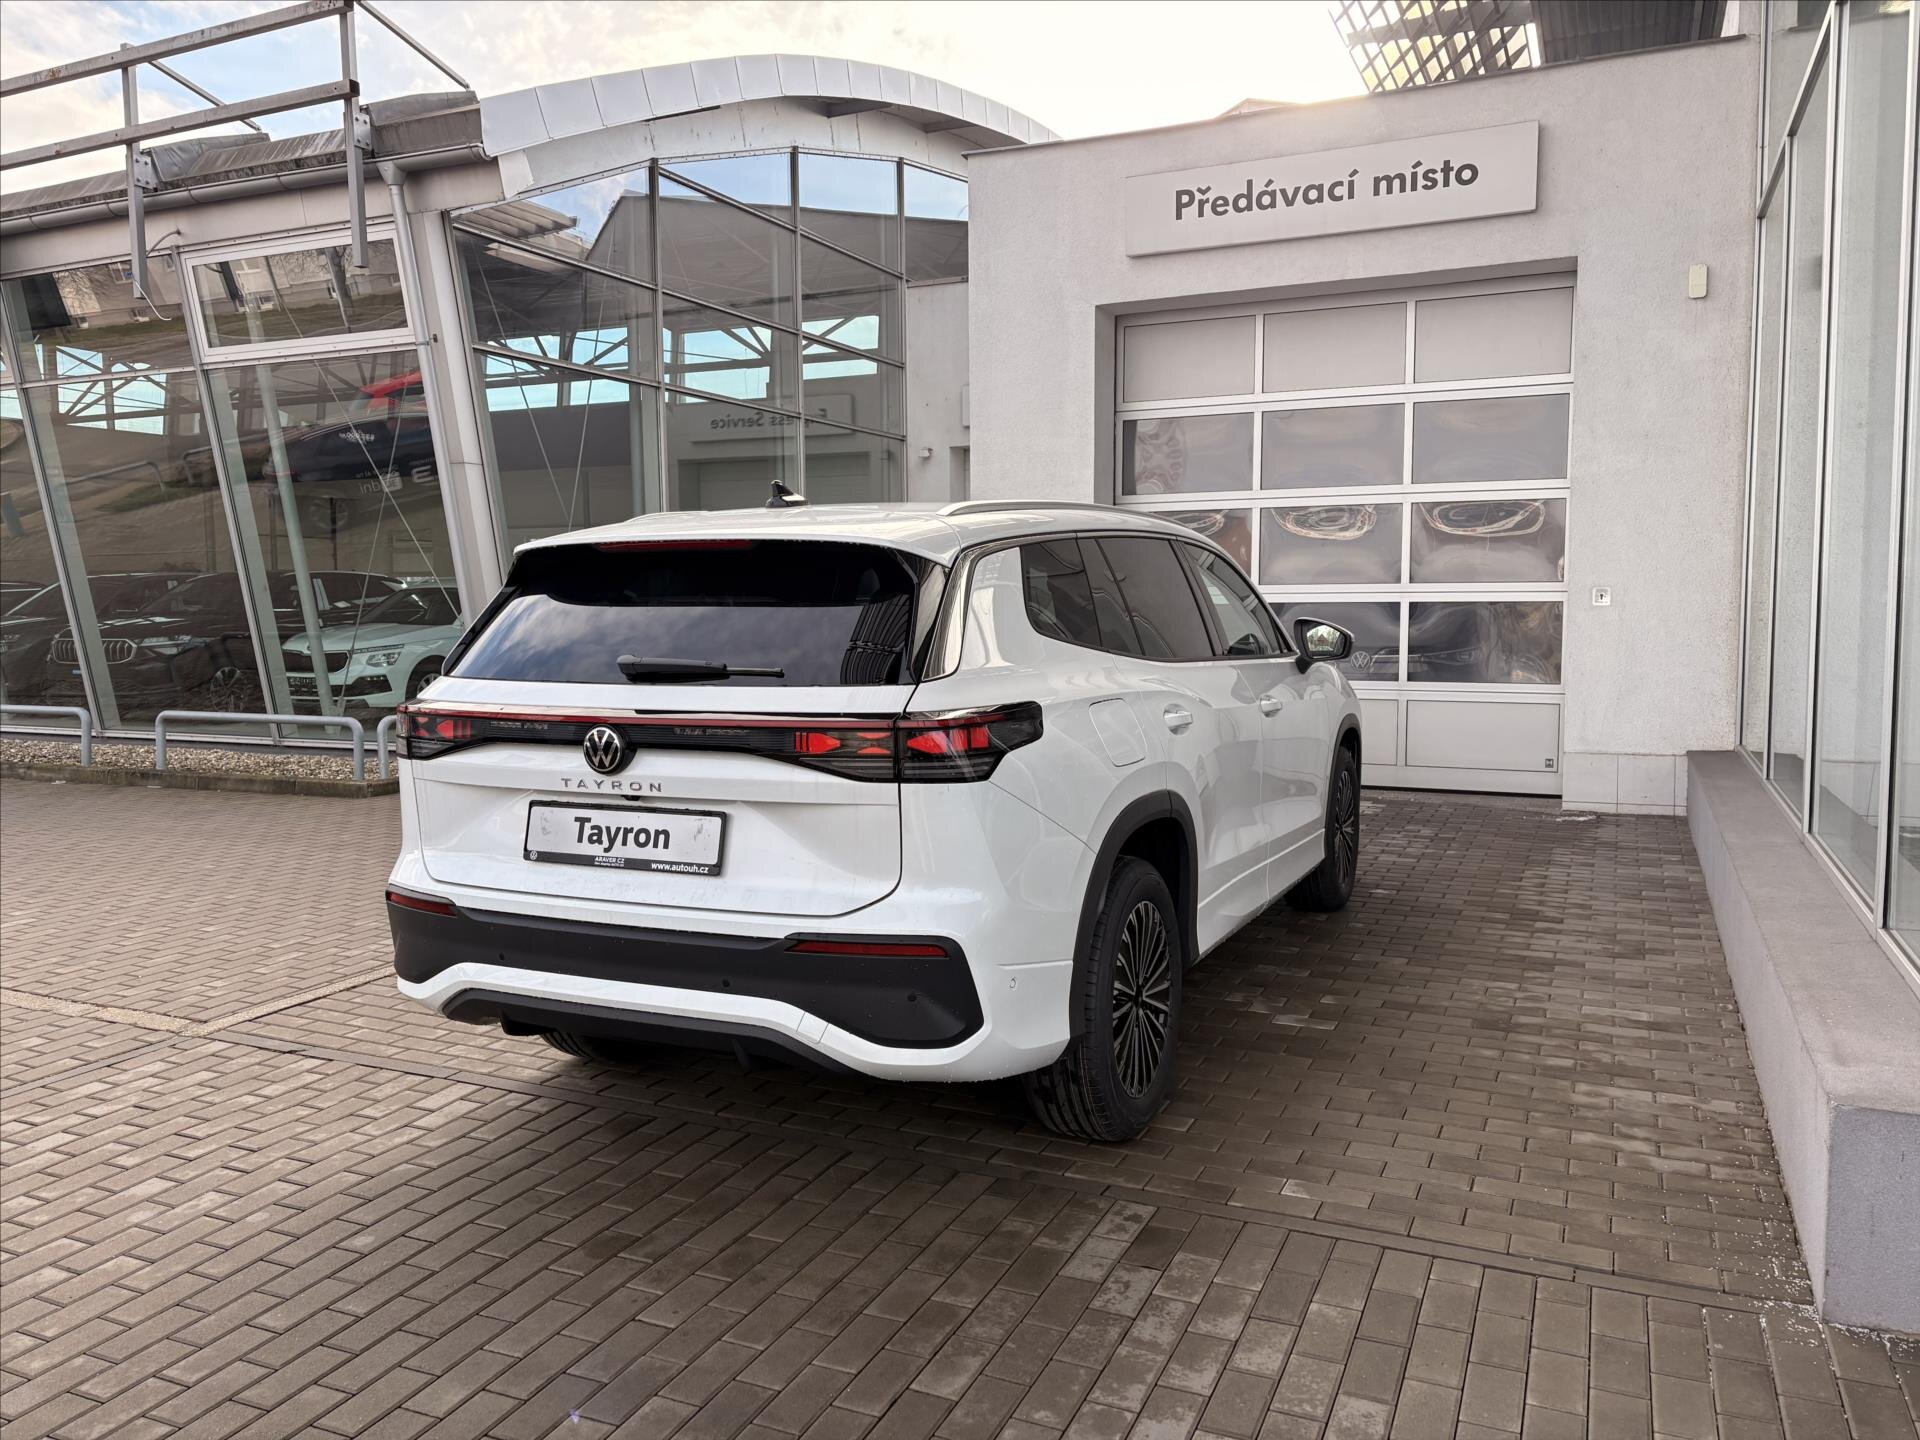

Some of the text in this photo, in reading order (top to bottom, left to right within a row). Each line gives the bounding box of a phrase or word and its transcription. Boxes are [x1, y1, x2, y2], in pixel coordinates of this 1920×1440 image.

[1175, 159, 1480, 221] Předávací místo
[561, 778, 663, 793] TAYRON
[574, 816, 671, 853] Tayron
[651, 862, 710, 874] www.autouh.cz
